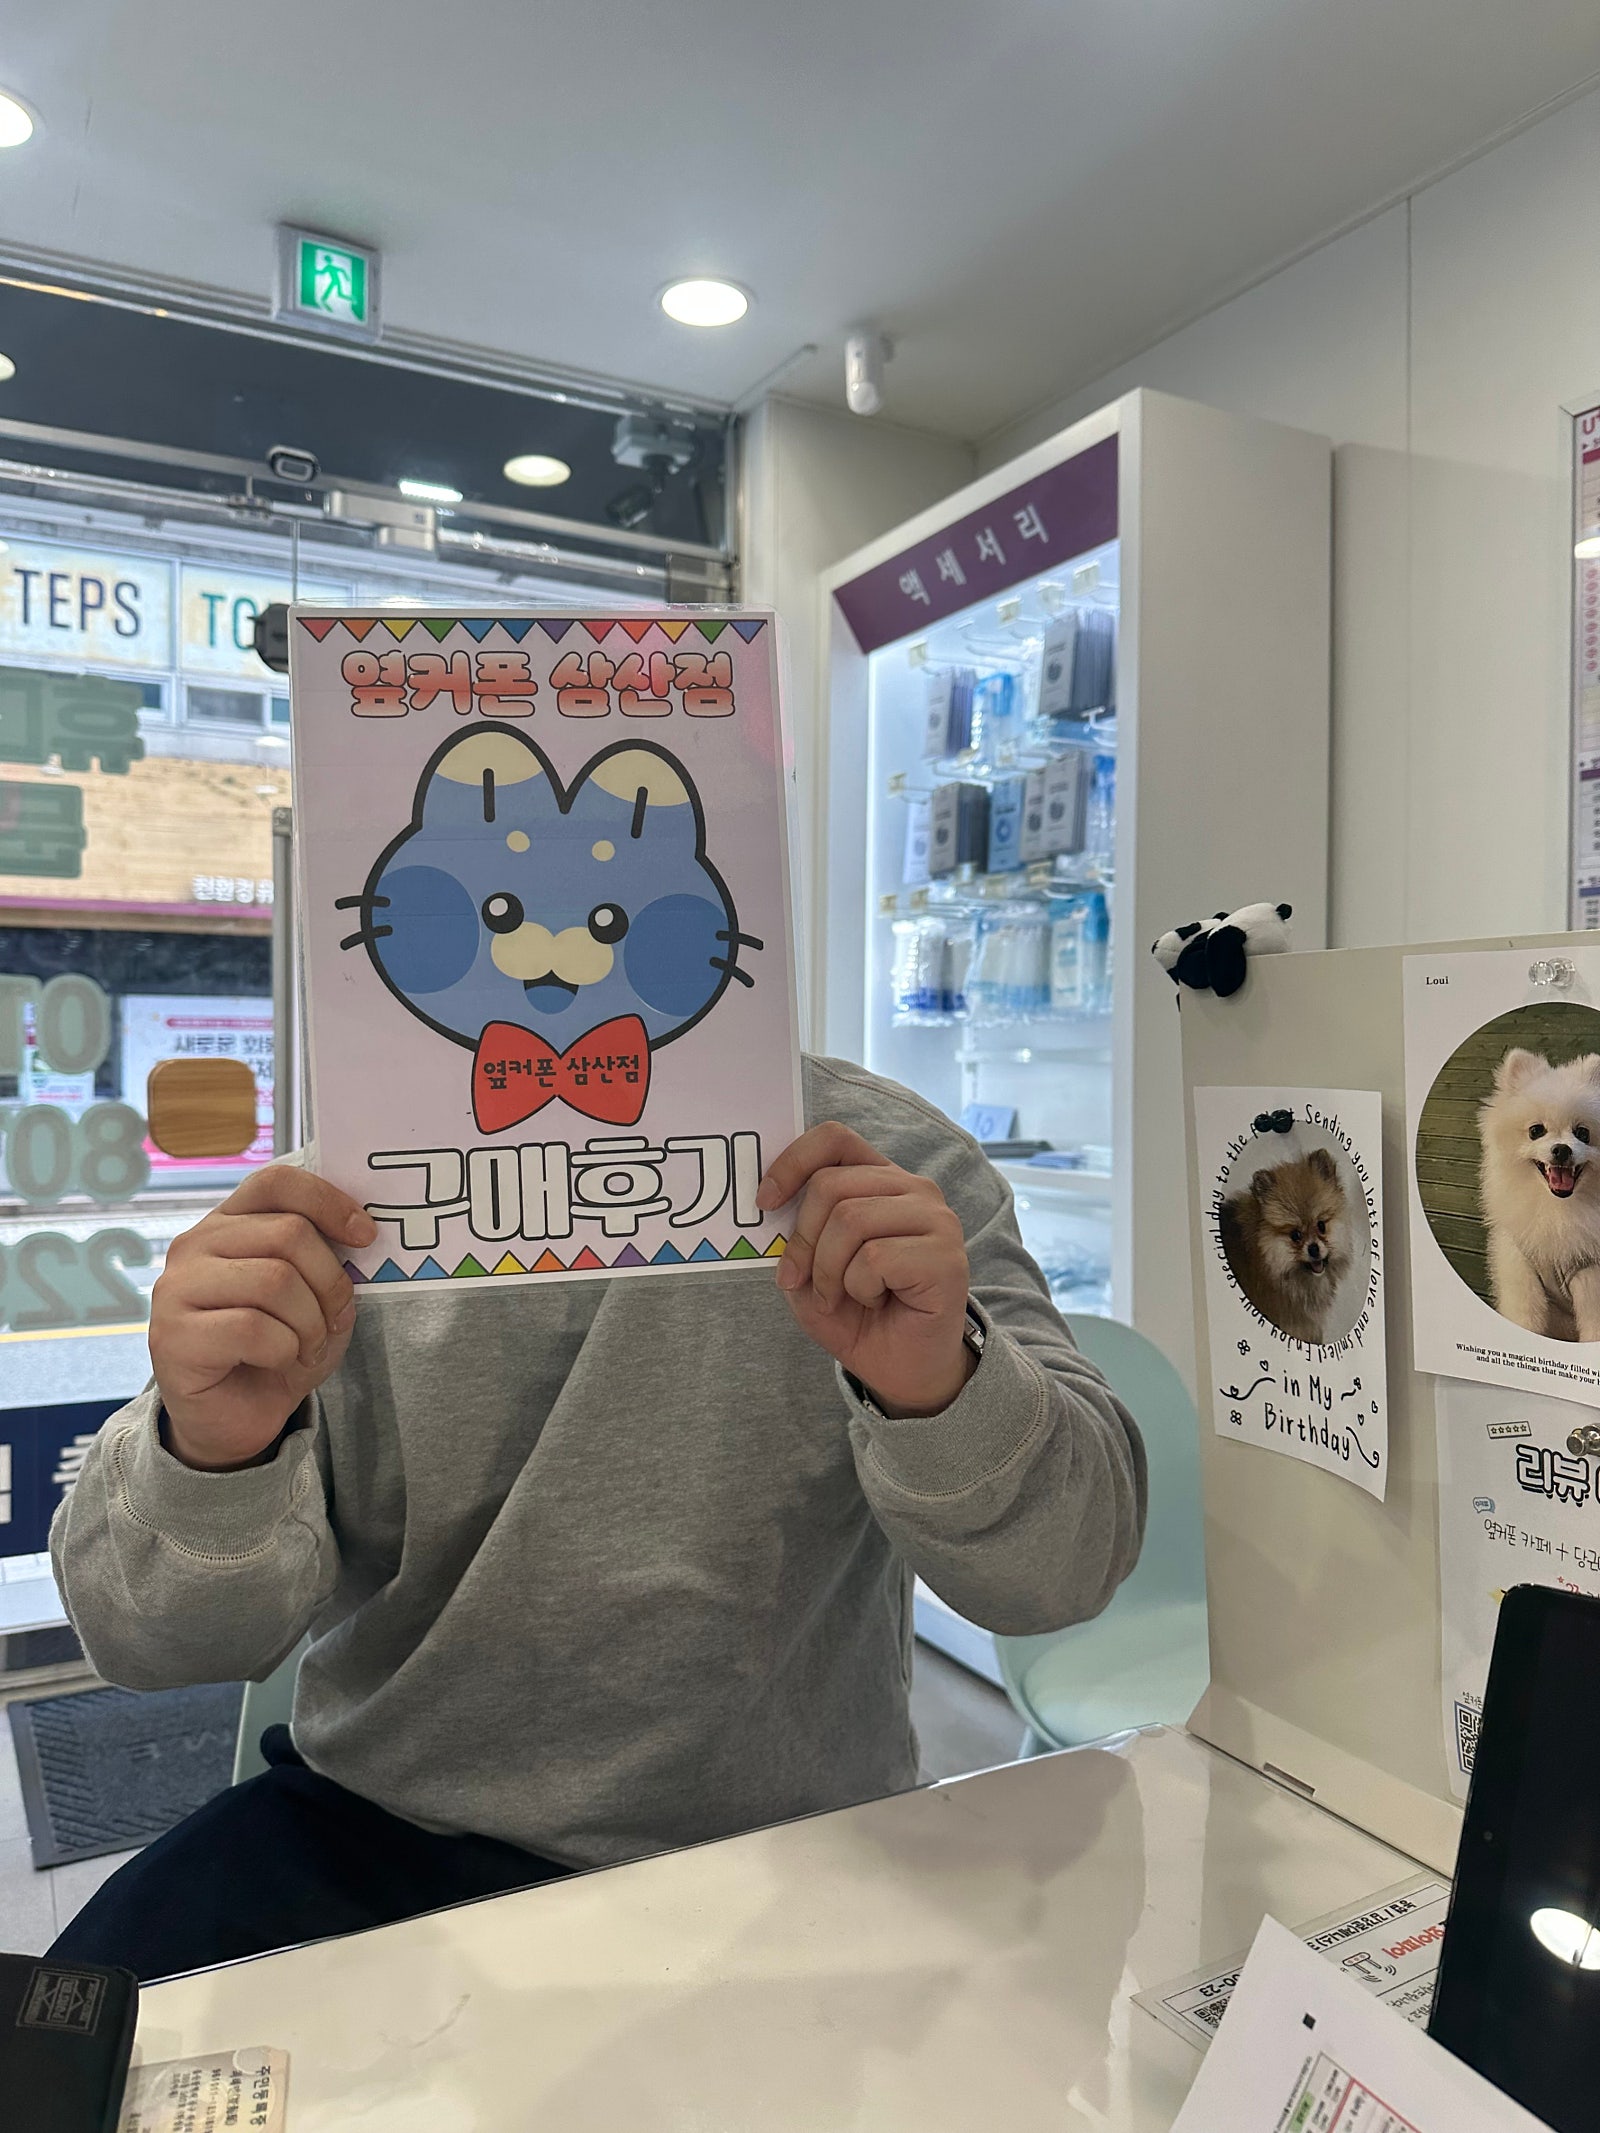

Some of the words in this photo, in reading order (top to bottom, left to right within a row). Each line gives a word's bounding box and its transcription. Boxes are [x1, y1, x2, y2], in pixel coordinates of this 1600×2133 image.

[899, 504, 1049, 606] 액세서리
[14, 568, 140, 637] TEPS
[200, 592, 263, 651] TO
[341, 650, 538, 718] 옆커폰
[549, 650, 735, 718] 삼산점
[1425, 975, 1450, 987] Loui
[482, 1058, 555, 1089] 옆커폰
[566, 1055, 641, 1086] 삼산점
[1305, 1103, 1352, 1151] Sending
[1227, 1134, 1247, 1161] the
[1351, 1151, 1369, 1182] you
[363, 1130, 763, 1251] 구매후기
[1216, 1165, 1230, 1184] to
[1205, 1189, 1225, 1221] day
[1365, 1187, 1378, 1229] lots
[1209, 1229, 1239, 1289] special
[1370, 1238, 1380, 1261] of
[1367, 1268, 1381, 1307] love
[1239, 1296, 1268, 1327] your
[1353, 1310, 1370, 1347] and
[1270, 1324, 1311, 1361] Enjoy
[1456, 1343, 1486, 1354] Wishing
[1487, 1348, 1501, 1357] you
[1508, 1353, 1537, 1364] magical
[1538, 1356, 1568, 1370] birthday
[1570, 1364, 1590, 1375] filled
[1476, 1355, 1490, 1363] and
[1502, 1359, 1515, 1367] the
[1516, 1361, 1540, 1372] things
[1541, 1366, 1557, 1376] that
[1558, 1370, 1578, 1380] make
[1579, 1375, 1595, 1385] your
[1283, 1370, 1300, 1398] in
[1308, 1373, 1333, 1410] My
[1263, 1402, 1351, 1462] Birthday
[1516, 1443, 1591, 1507] 리뷰
[1484, 1518, 1517, 1546] 옆커폰
[1520, 1531, 1552, 1555] 카페
[1574, 1546, 1600, 1571] 당근
[249, 2065, 271, 2126] 주민등록증
